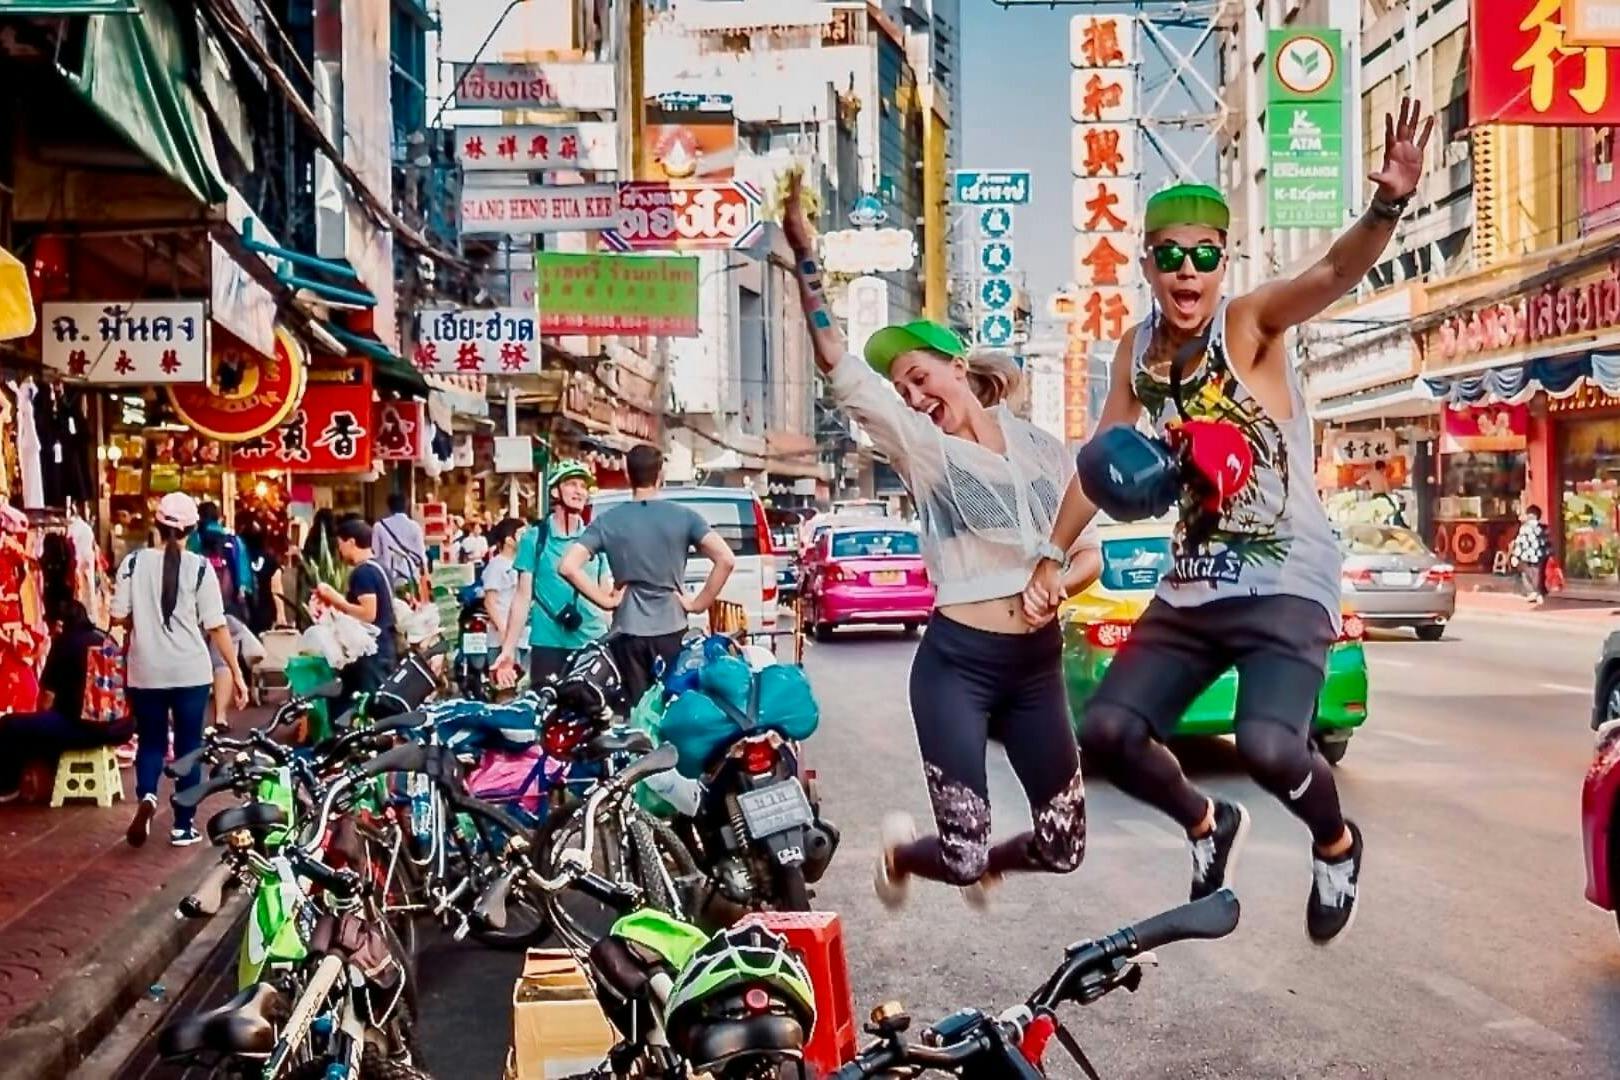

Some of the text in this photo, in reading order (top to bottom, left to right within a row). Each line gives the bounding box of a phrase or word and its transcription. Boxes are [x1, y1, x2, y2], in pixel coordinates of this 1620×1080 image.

[1289, 138, 1322, 150] ATM
[462, 197, 613, 221] SIANG HENG HUA KEE
